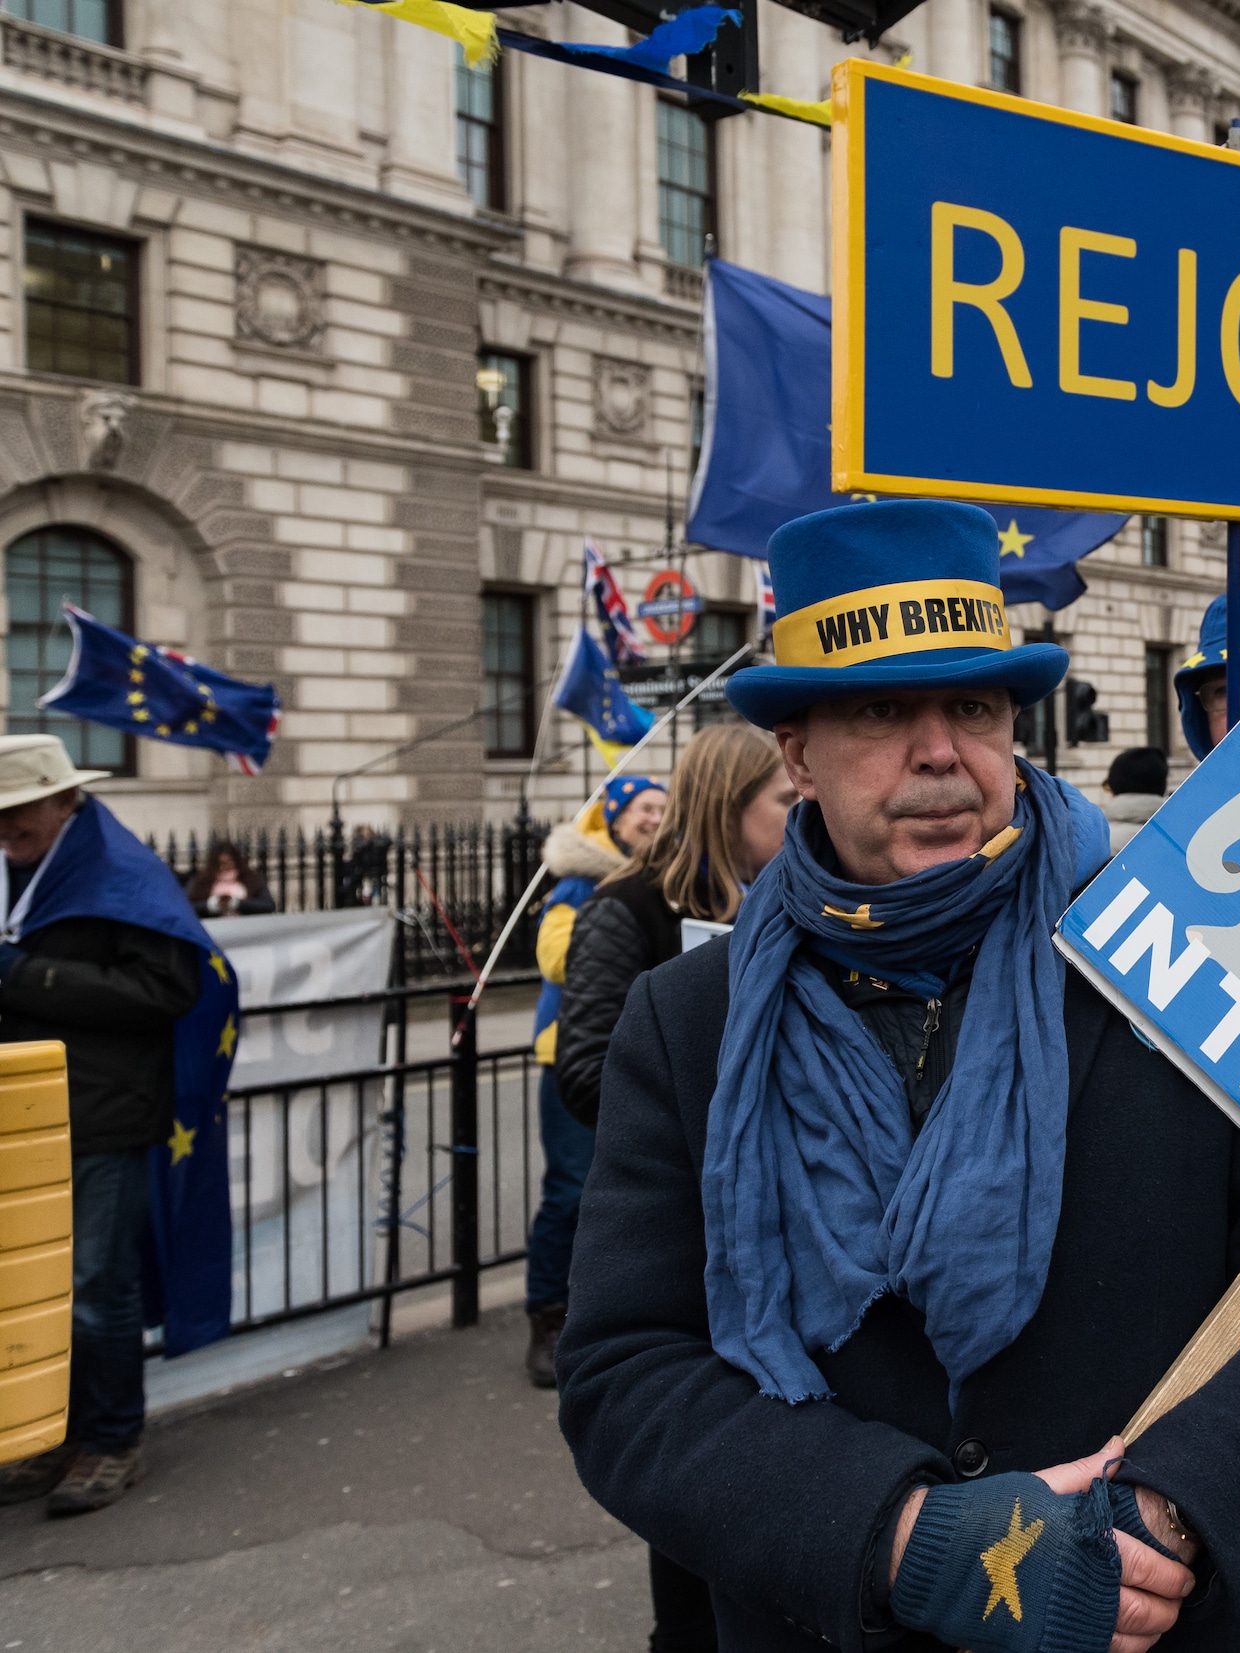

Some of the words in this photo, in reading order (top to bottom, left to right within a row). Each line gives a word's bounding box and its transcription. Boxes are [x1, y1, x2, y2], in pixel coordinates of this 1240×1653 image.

[815, 603, 890, 655] WHY
[899, 597, 1004, 637] BREXIT?
[1082, 877, 1212, 1012] IN
